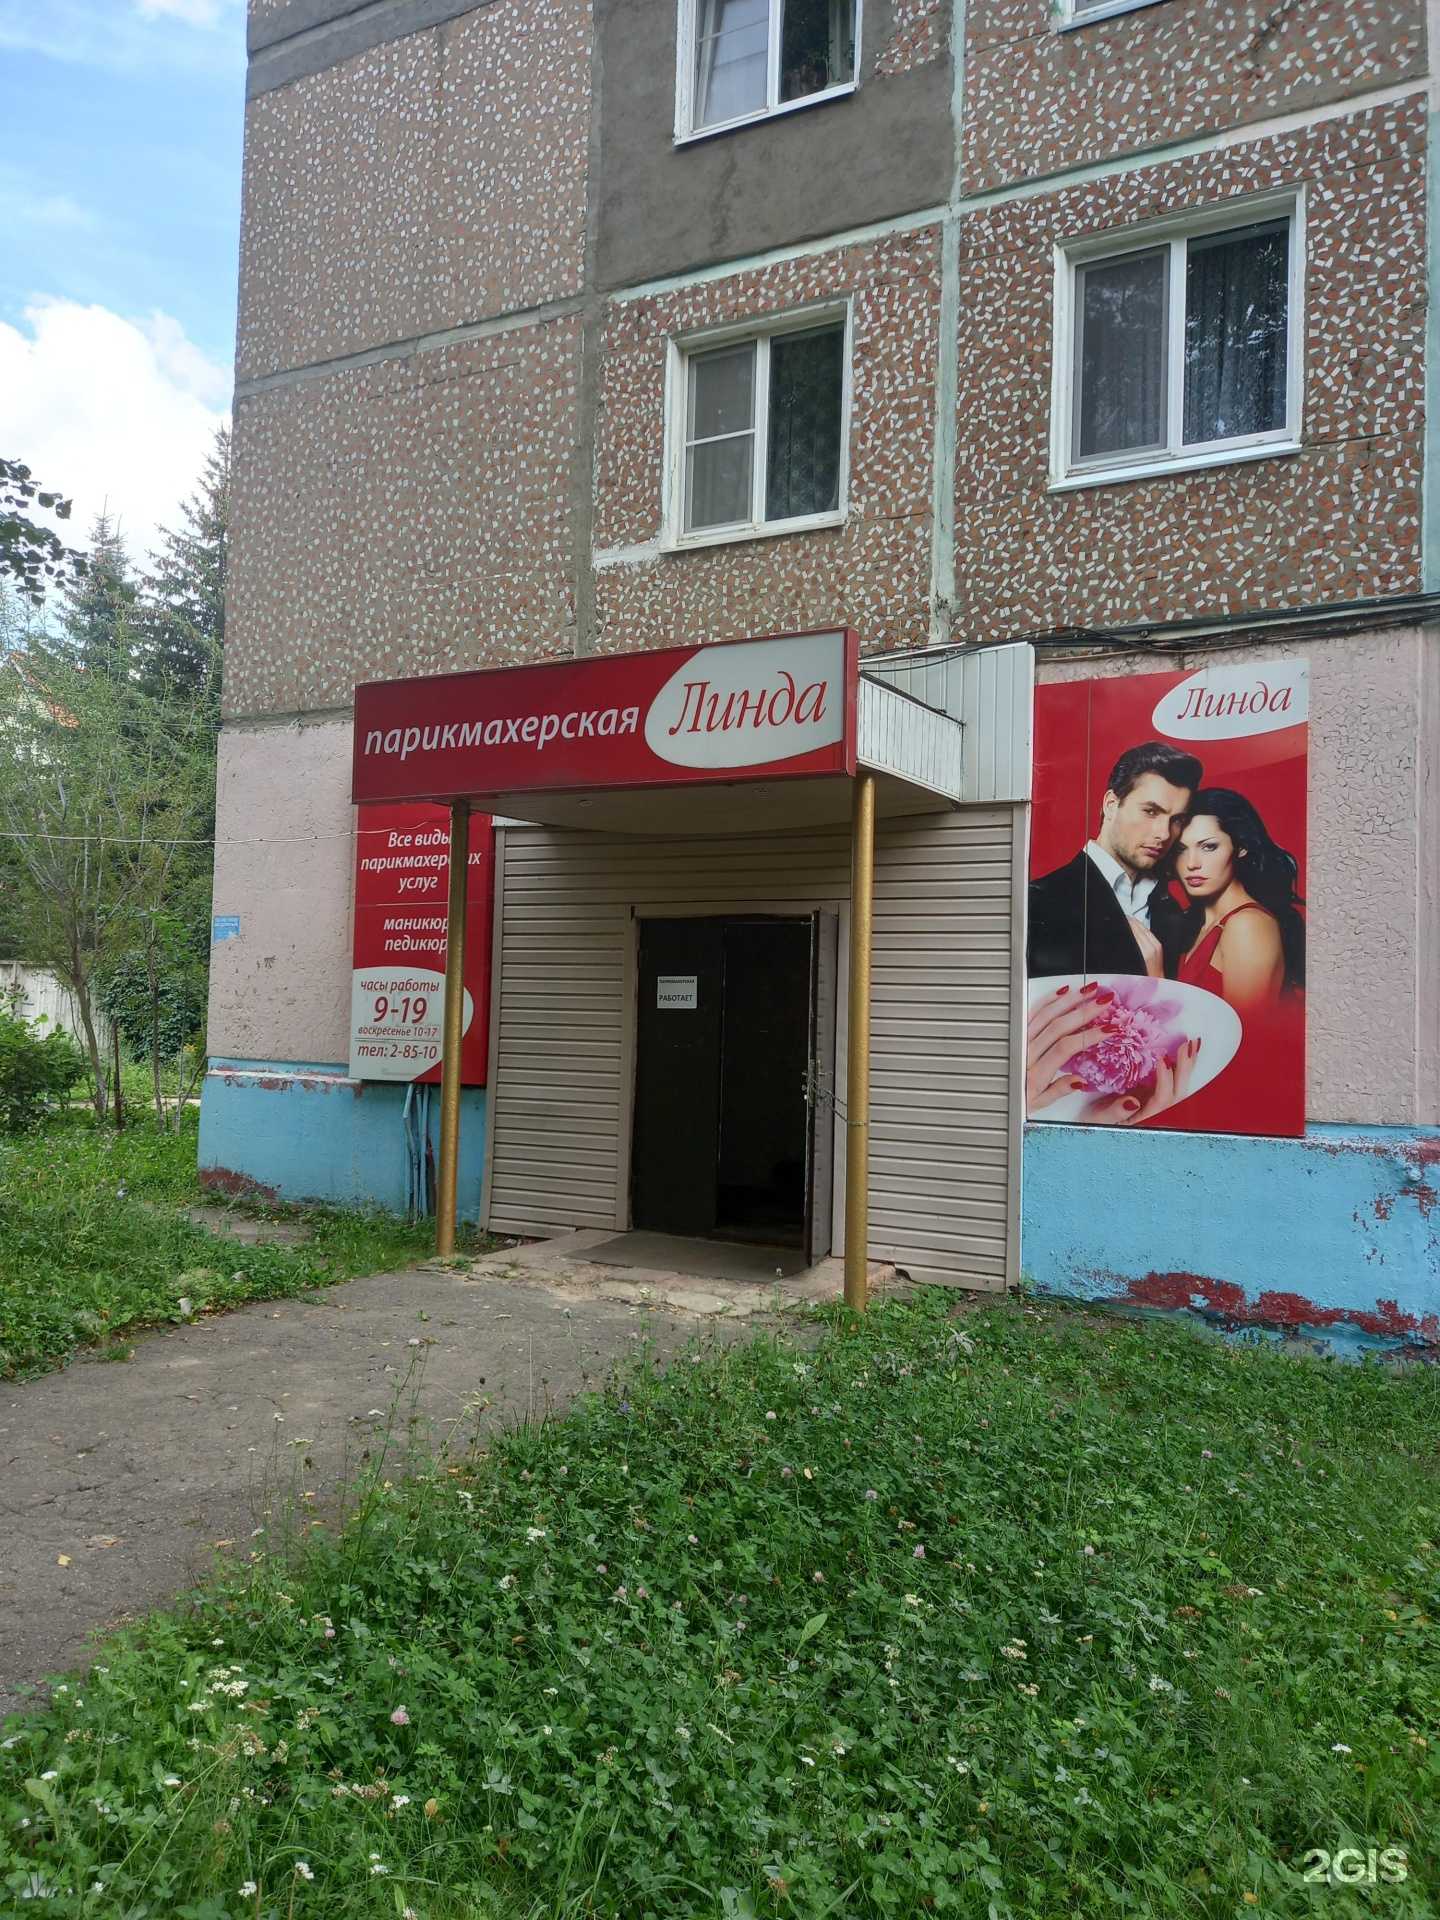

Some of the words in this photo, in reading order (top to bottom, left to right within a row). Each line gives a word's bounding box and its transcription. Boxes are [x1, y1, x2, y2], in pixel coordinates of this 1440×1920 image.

[1177, 681, 1292, 719] Линда
[364, 704, 640, 760] парикмахерская
[668, 671, 828, 736] Линда
[388, 832, 413, 848] Все
[398, 876, 438, 893] услуг
[384, 916, 448, 933] маникюр
[385, 935, 447, 954] педикюр
[360, 980, 389, 992] часы
[390, 978, 440, 993] работы
[373, 996, 427, 1024] 9-19
[358, 1026, 411, 1037] воскресенье
[413, 1027, 437, 1037] 10-17
[357, 1043, 388, 1058] тел:
[390, 1043, 437, 1059] 2-85-10
